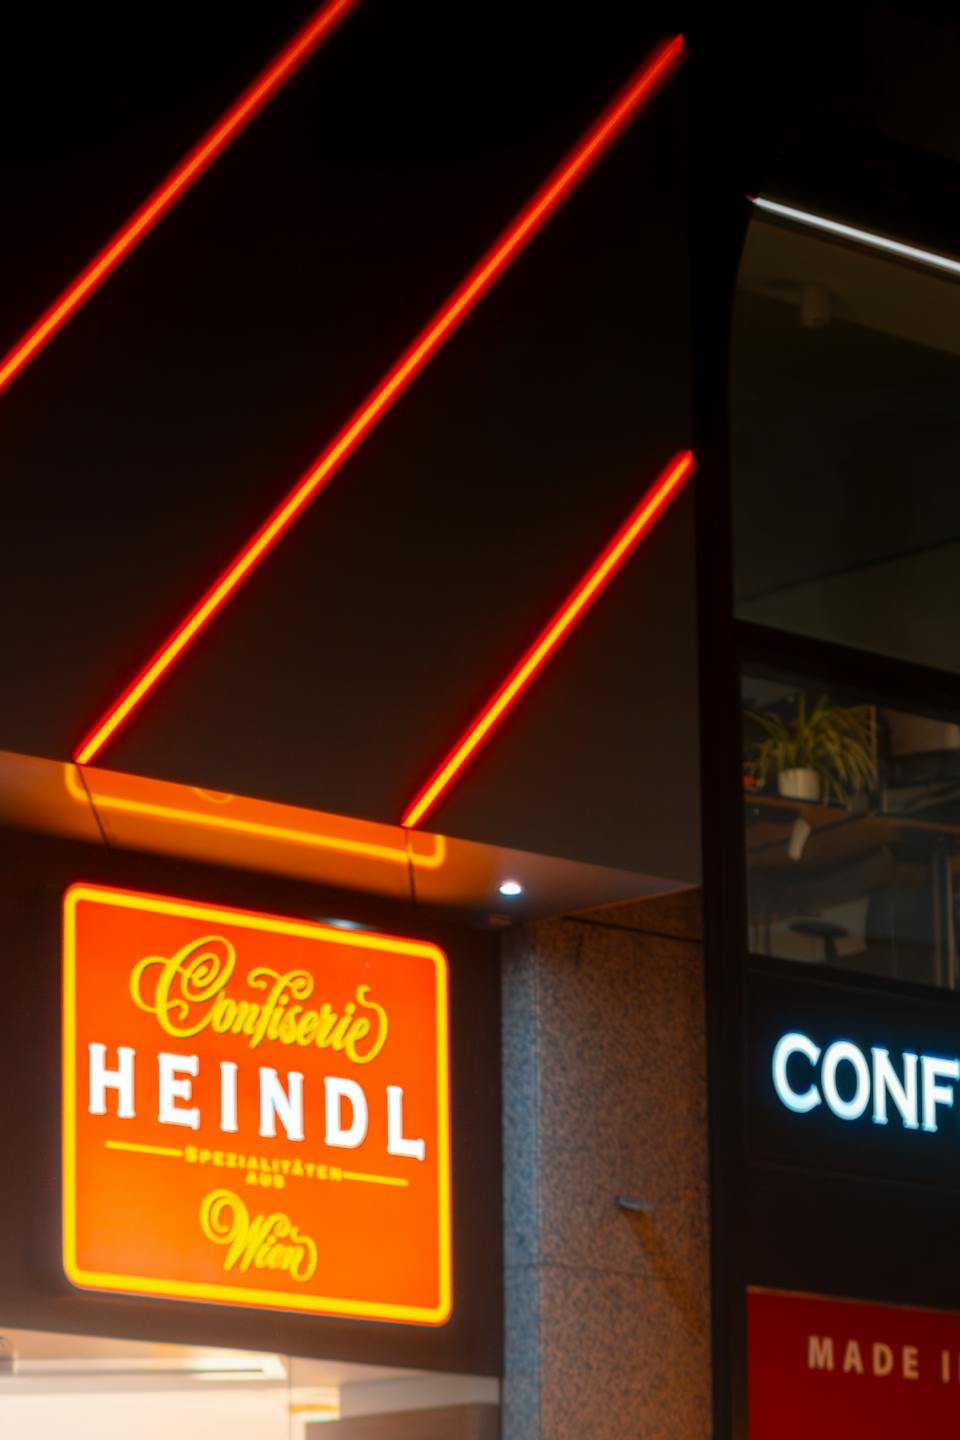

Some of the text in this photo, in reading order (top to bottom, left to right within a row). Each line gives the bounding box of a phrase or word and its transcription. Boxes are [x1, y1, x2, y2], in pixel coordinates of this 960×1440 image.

[129, 935, 388, 1064] Confiserie
[88, 1042, 425, 1161] HEINDL
[772, 1032, 960, 1133] CONF
[184, 1145, 343, 1182] SPEZIALITÄTEN
[245, 1170, 286, 1189] AUS
[199, 1189, 318, 1282] Wien
[808, 1335, 960, 1384] MADE I
